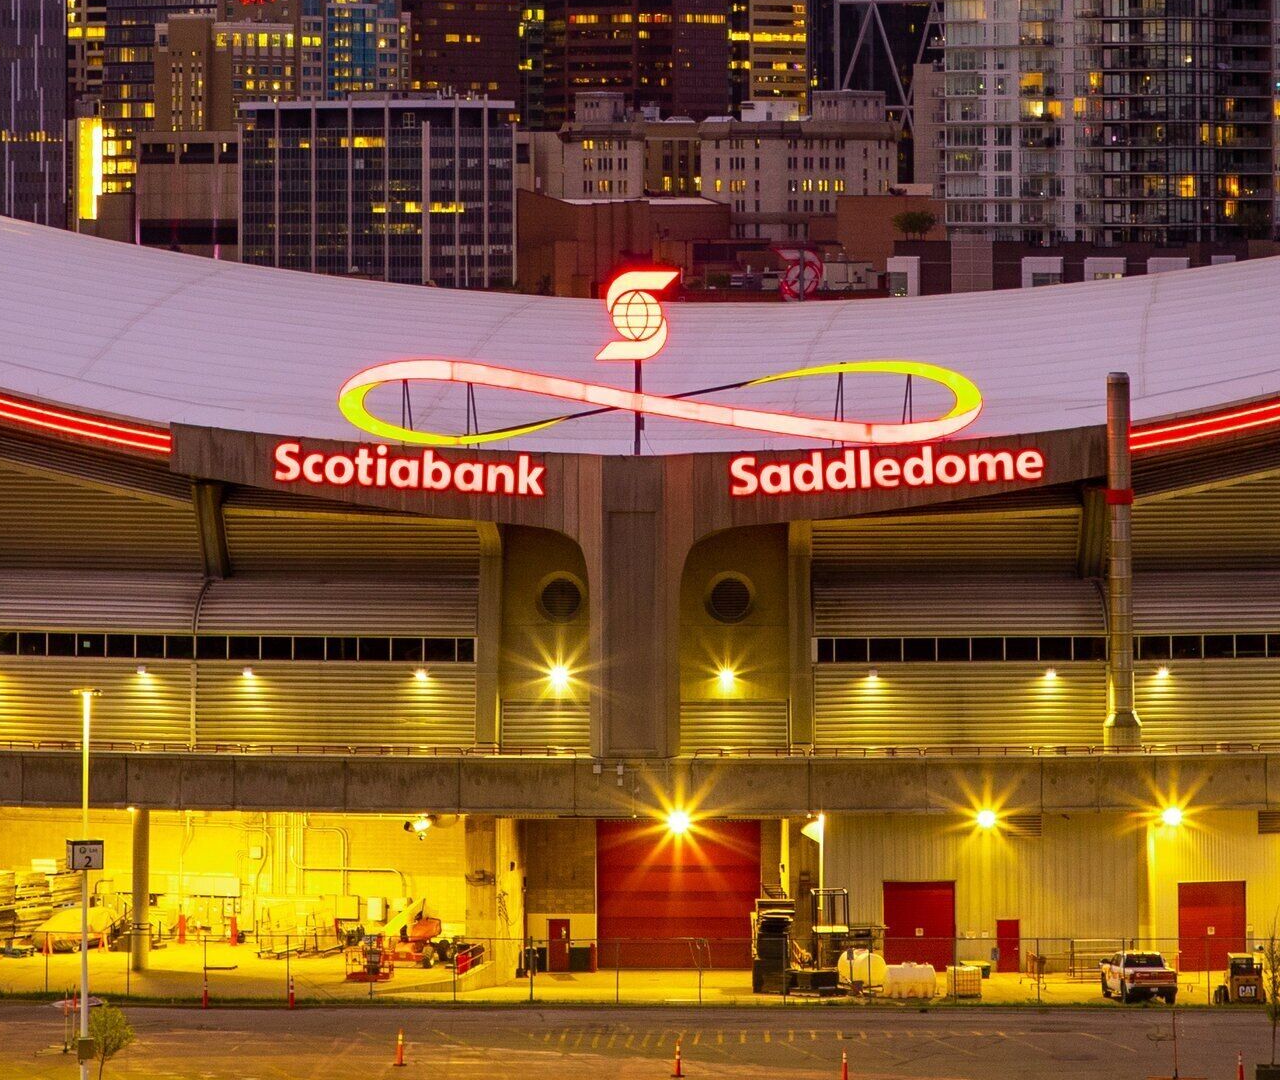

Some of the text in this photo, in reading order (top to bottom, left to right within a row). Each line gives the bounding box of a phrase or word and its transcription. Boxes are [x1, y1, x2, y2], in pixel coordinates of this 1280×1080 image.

[273, 442, 546, 496] Scotiabank
[729, 445, 1045, 496] Saddledome
[84, 855, 92, 868] 2
[1239, 985, 1256, 997] CAT
